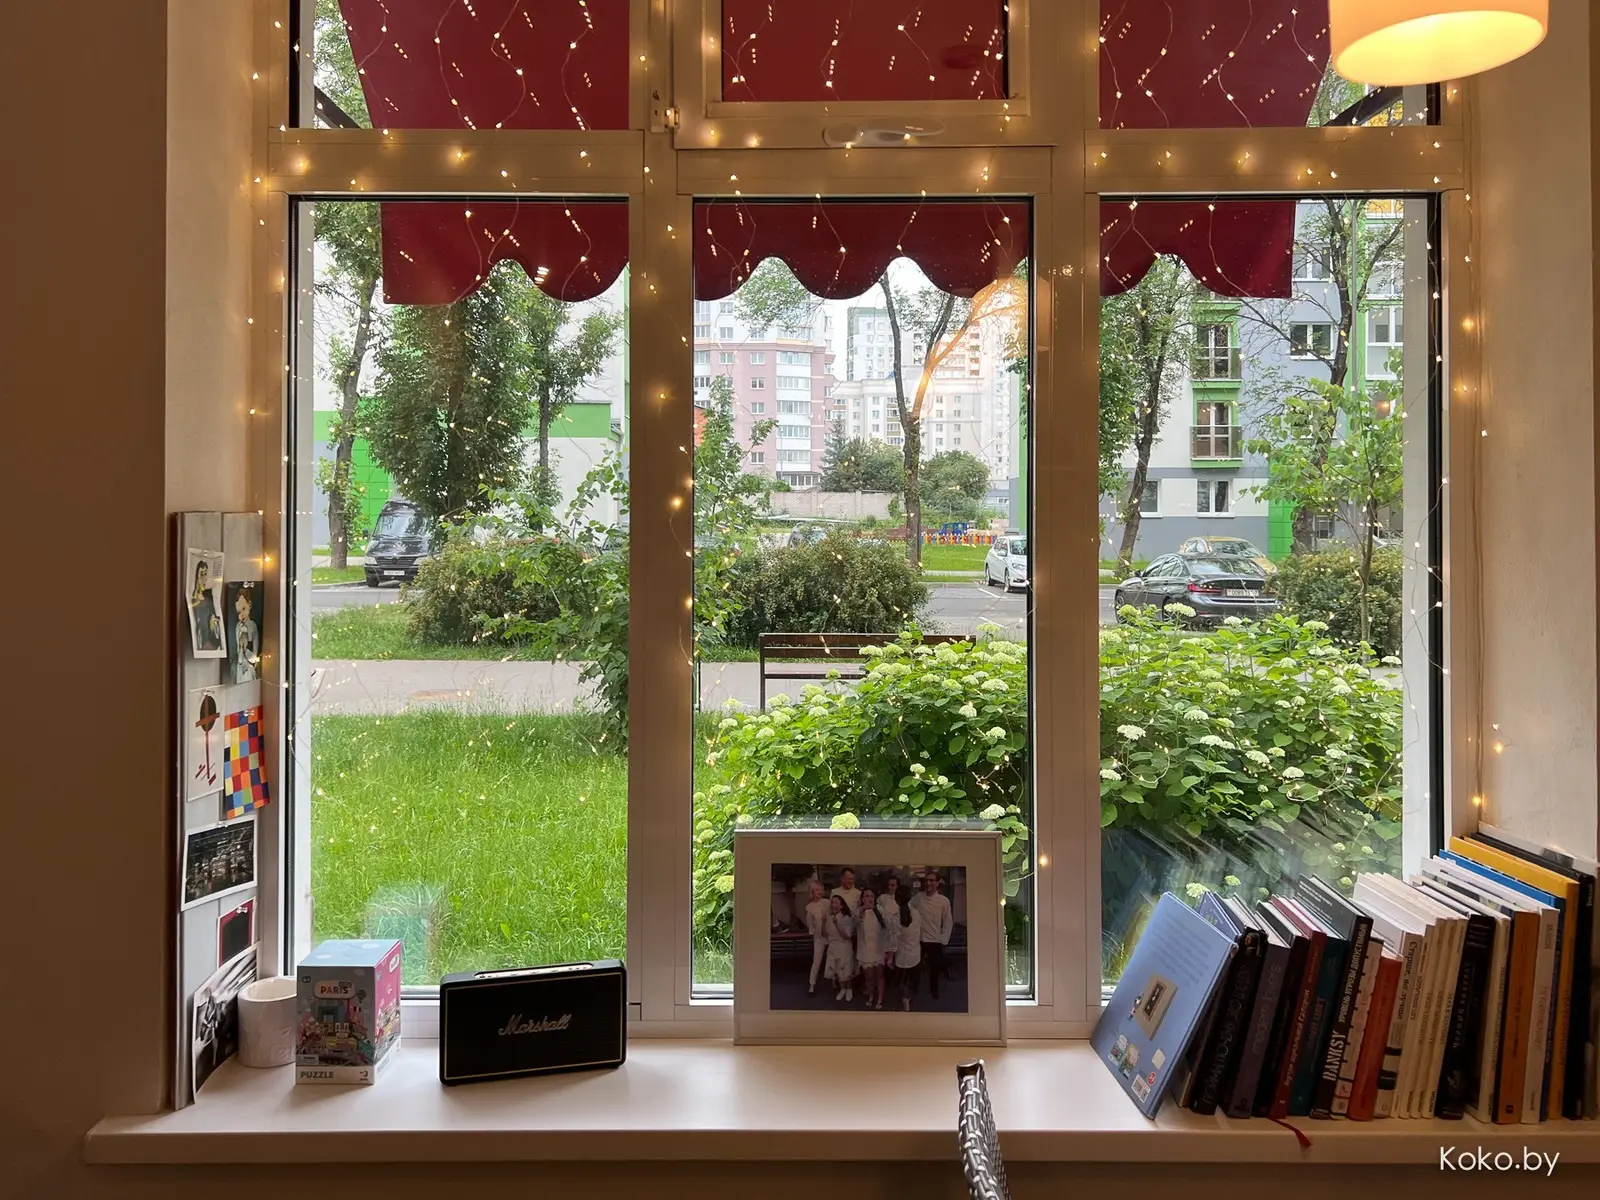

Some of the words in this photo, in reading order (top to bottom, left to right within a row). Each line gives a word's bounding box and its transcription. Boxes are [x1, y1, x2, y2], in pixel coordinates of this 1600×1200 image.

[1350, 923, 1367, 969] ДОПУСТИМЫЙ
[320, 986, 349, 994] PARIS
[1345, 969, 1356, 995] УГРОЗЫ
[498, 1013, 572, 1035] Marshall
[1322, 1030, 1346, 1081] BANKSY
[300, 1070, 334, 1078] PUZZLE
